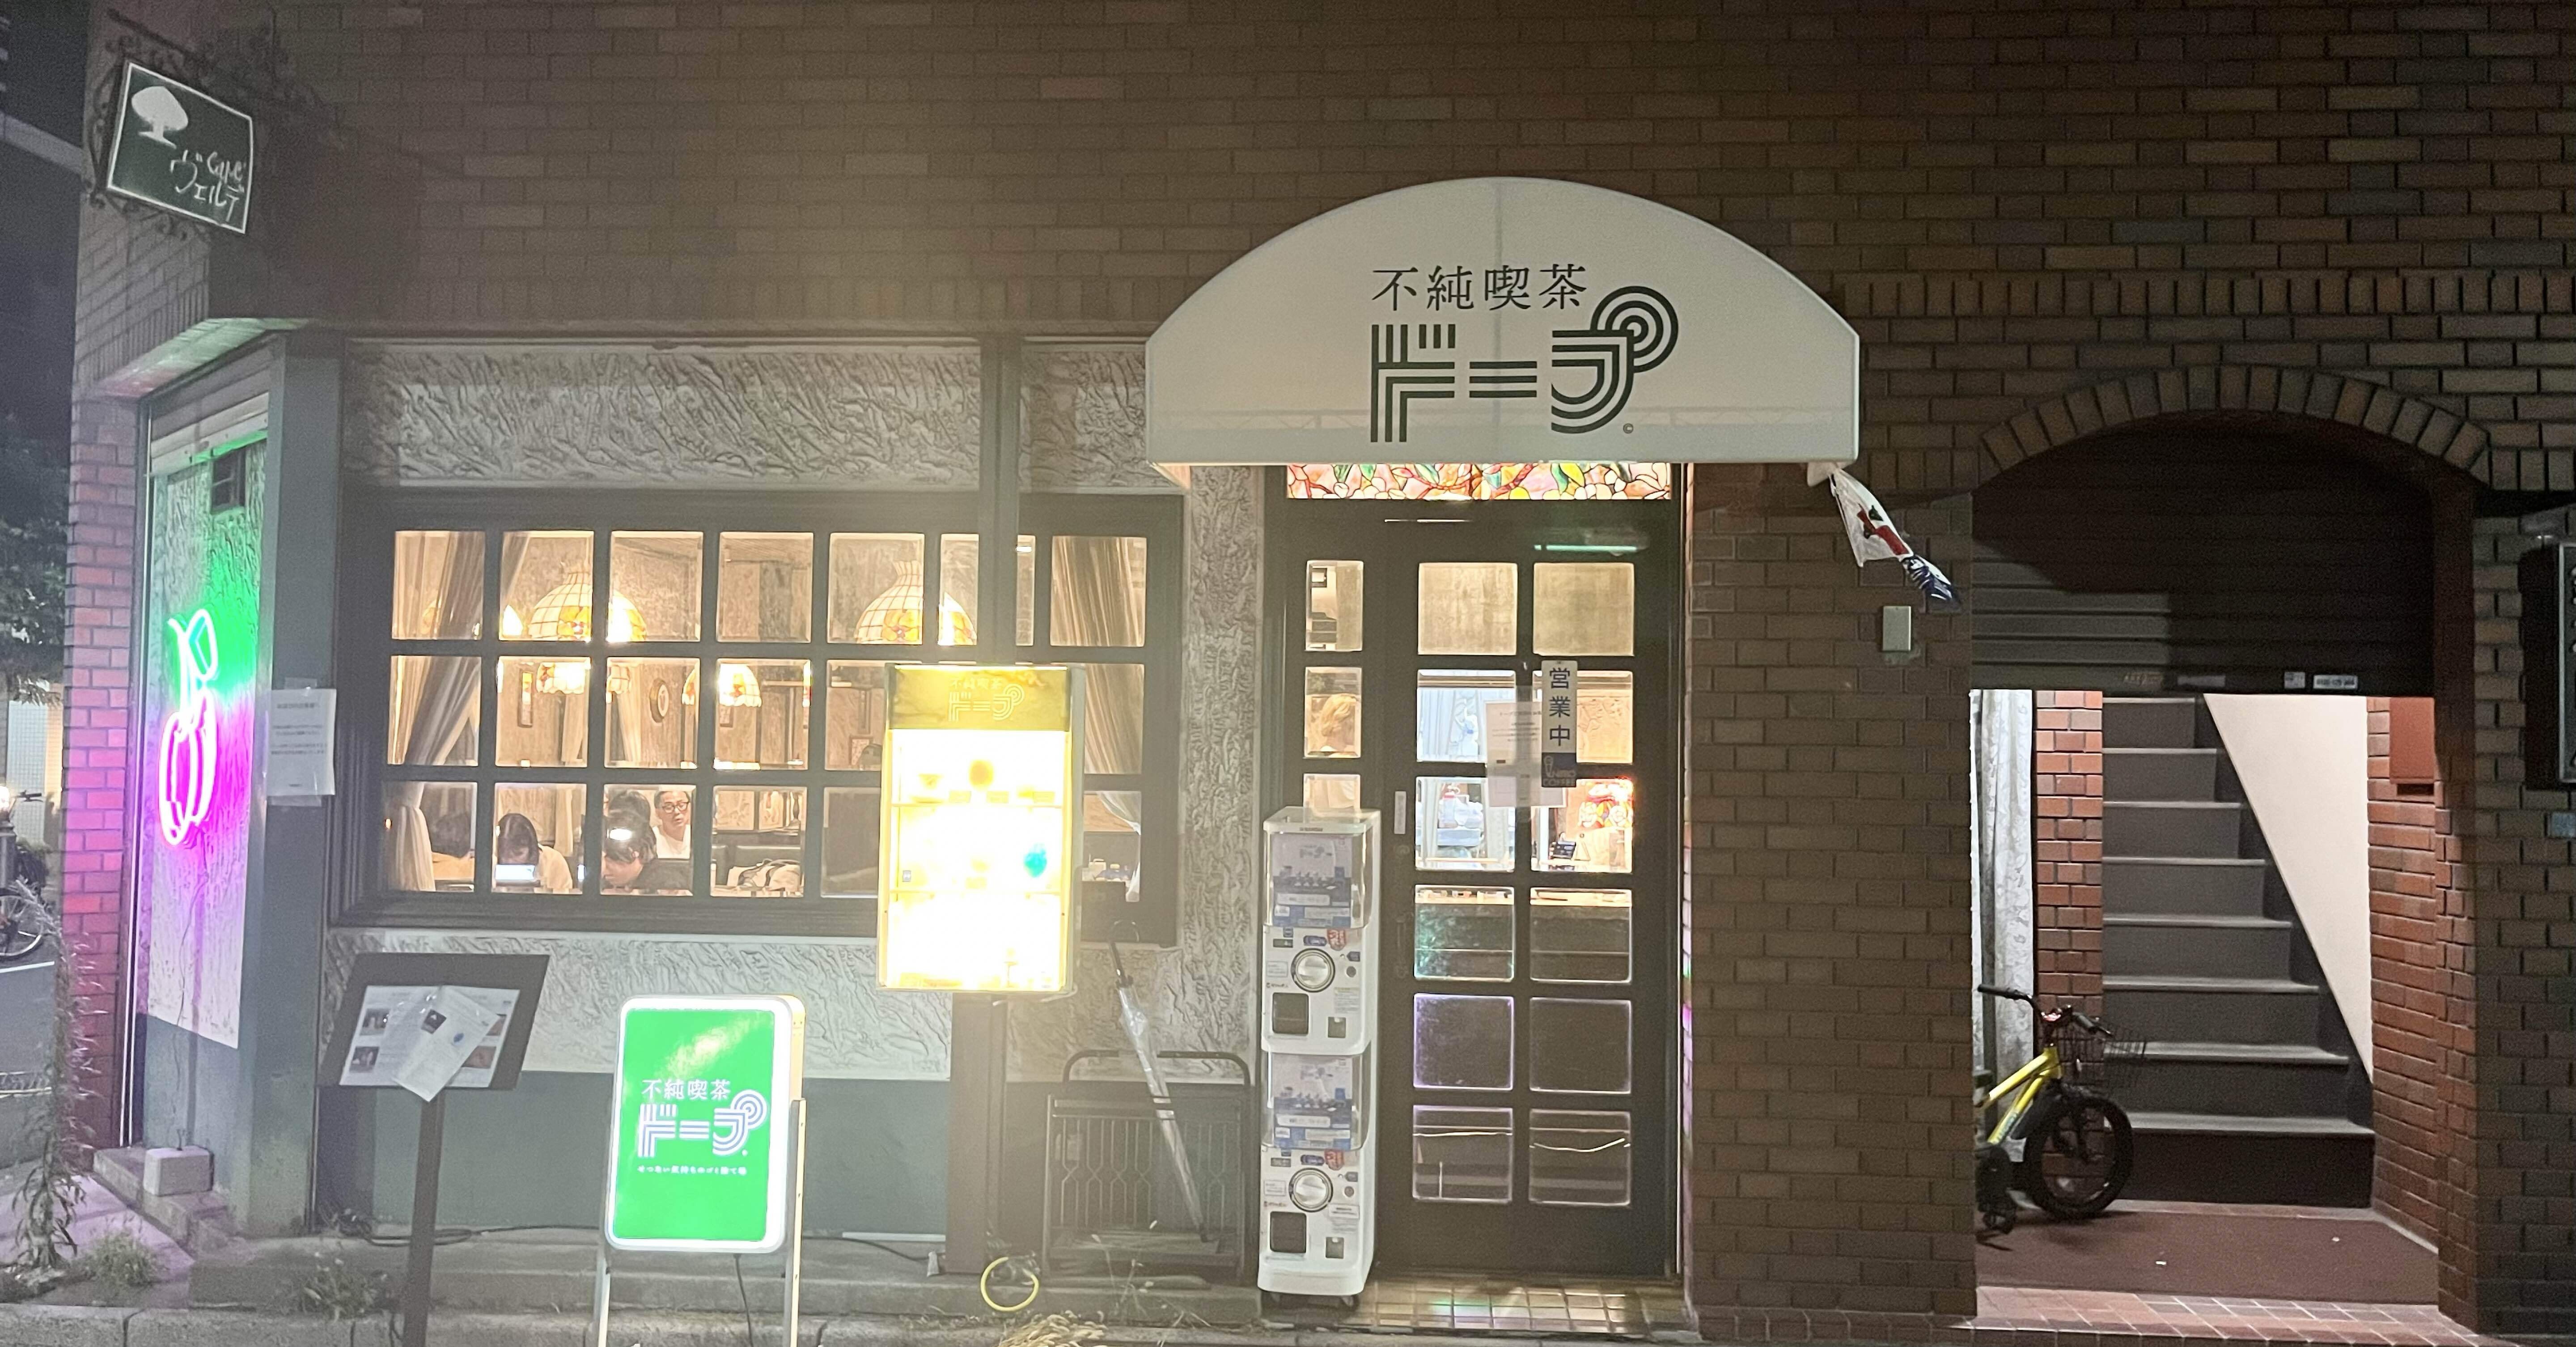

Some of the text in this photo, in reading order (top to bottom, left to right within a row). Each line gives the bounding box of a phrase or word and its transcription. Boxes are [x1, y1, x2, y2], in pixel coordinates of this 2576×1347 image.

[1372, 264, 1587, 311] 不純喫茶
[1370, 285, 1679, 442] ドープ
[948, 684, 1025, 722] ドープ
[1549, 667, 1571, 746] 営業中
[641, 1079, 731, 1100] 不純喫茶
[638, 1089, 767, 1158] ドープ
